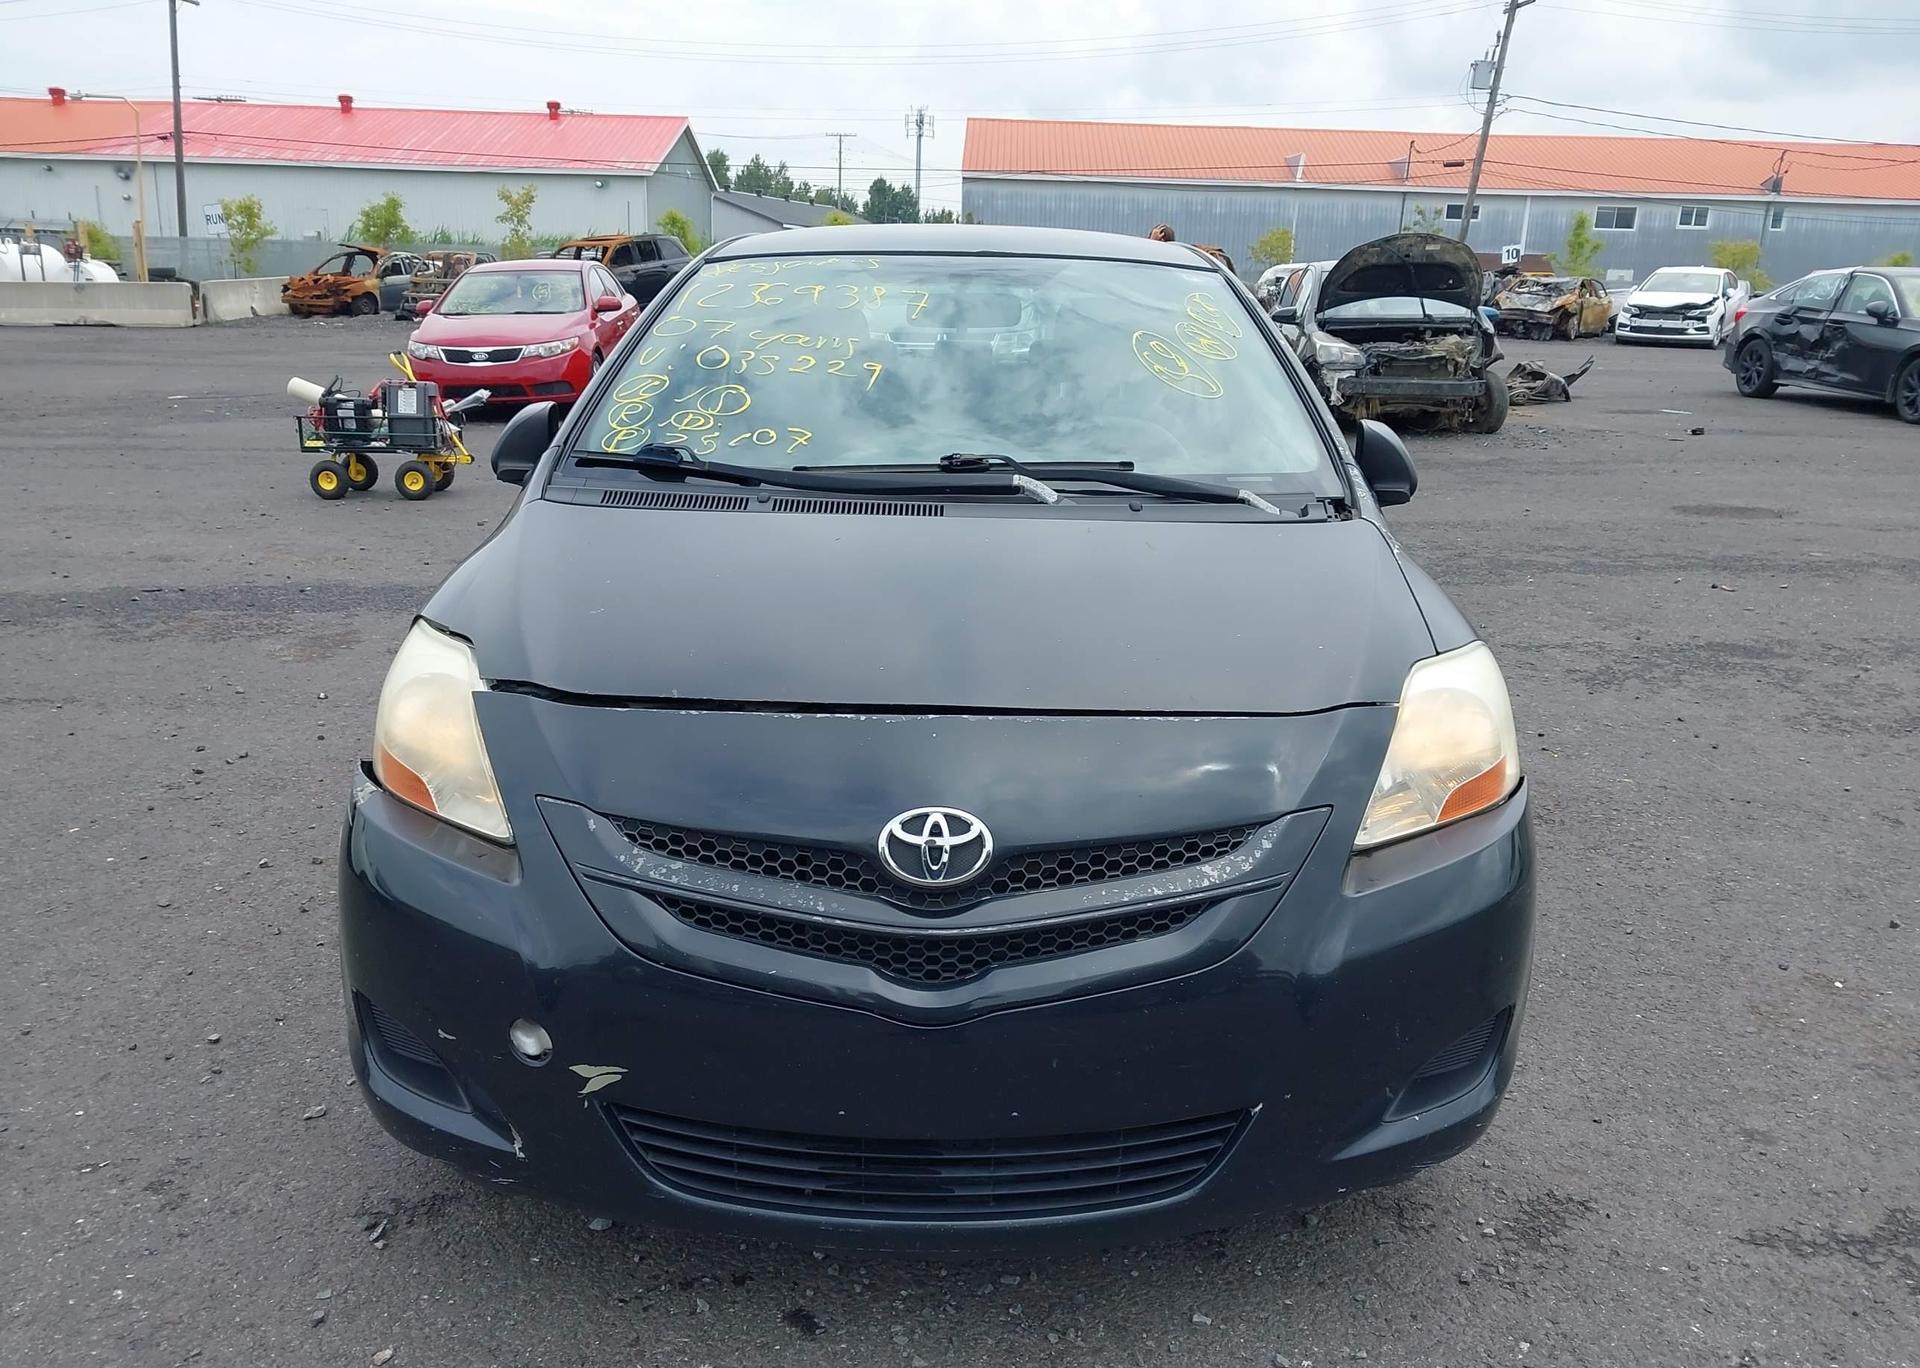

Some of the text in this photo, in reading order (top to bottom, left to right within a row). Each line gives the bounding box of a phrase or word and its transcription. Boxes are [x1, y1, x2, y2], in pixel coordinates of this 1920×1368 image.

[205, 213, 224, 225] RUN
[1505, 248, 1518, 260] 10
[653, 315, 737, 339] 07
